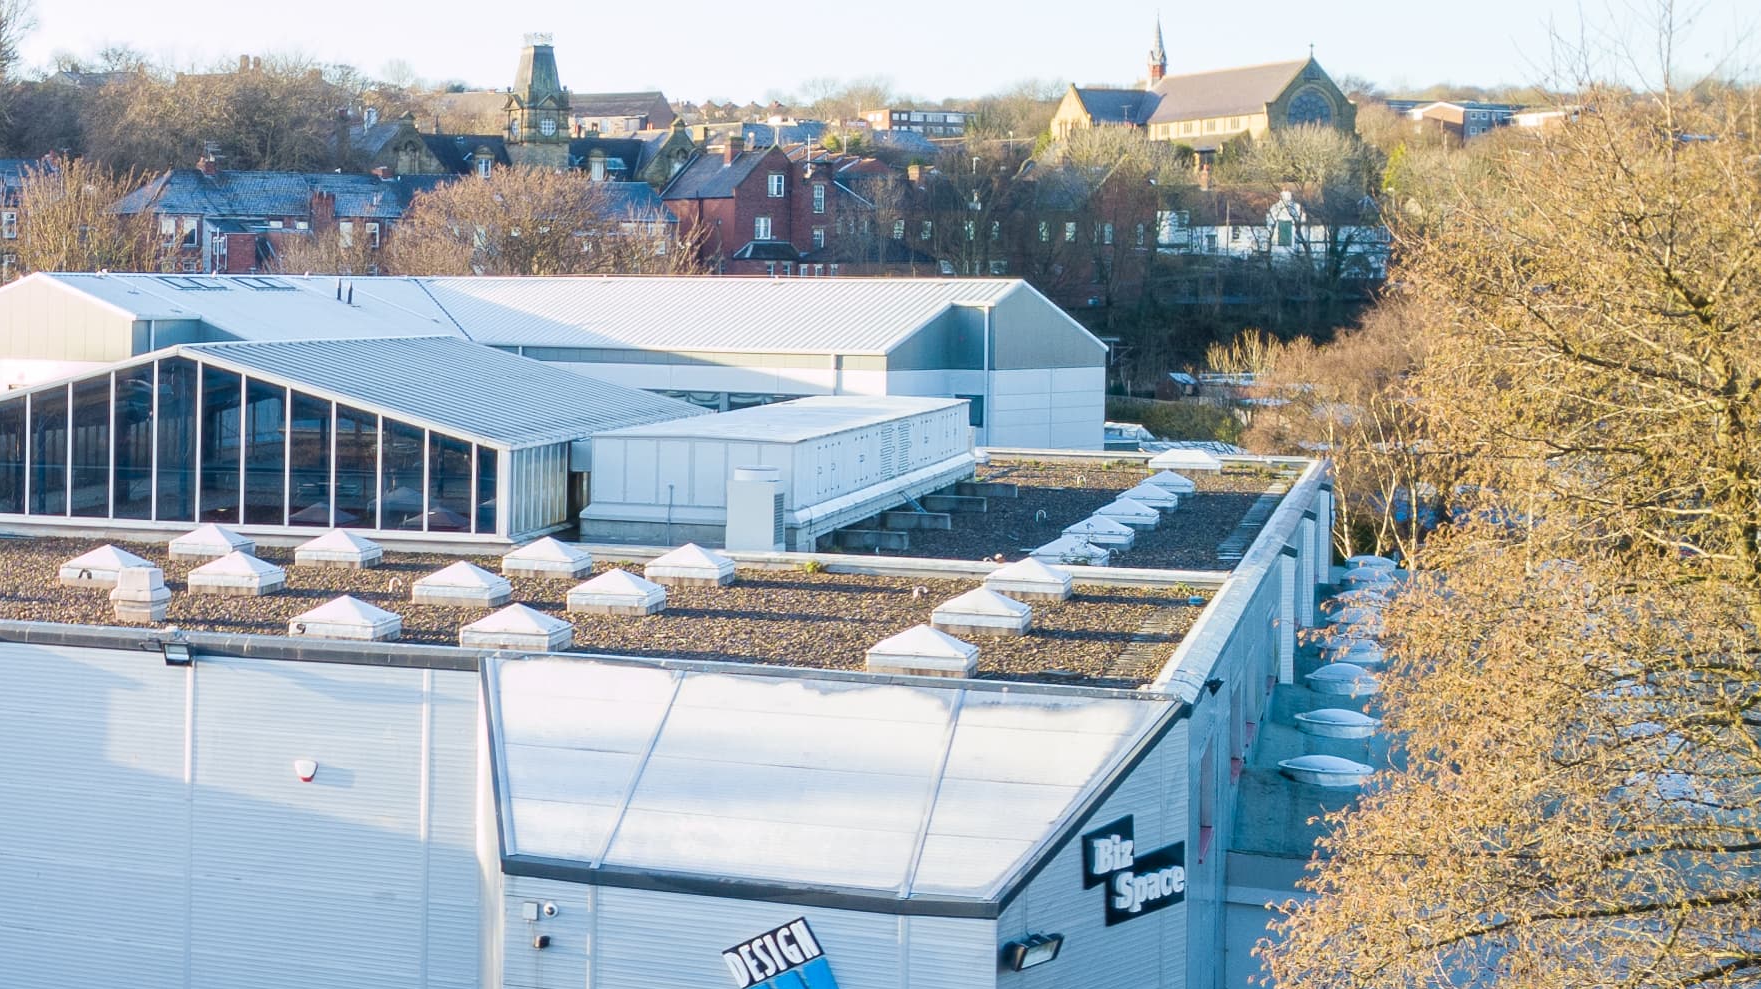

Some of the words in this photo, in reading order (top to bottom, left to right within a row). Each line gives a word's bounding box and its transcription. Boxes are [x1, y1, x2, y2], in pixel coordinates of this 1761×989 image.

[1093, 834, 1134, 875] Biz
[1115, 865, 1185, 912] Space
[722, 919, 821, 989] DESIGN
